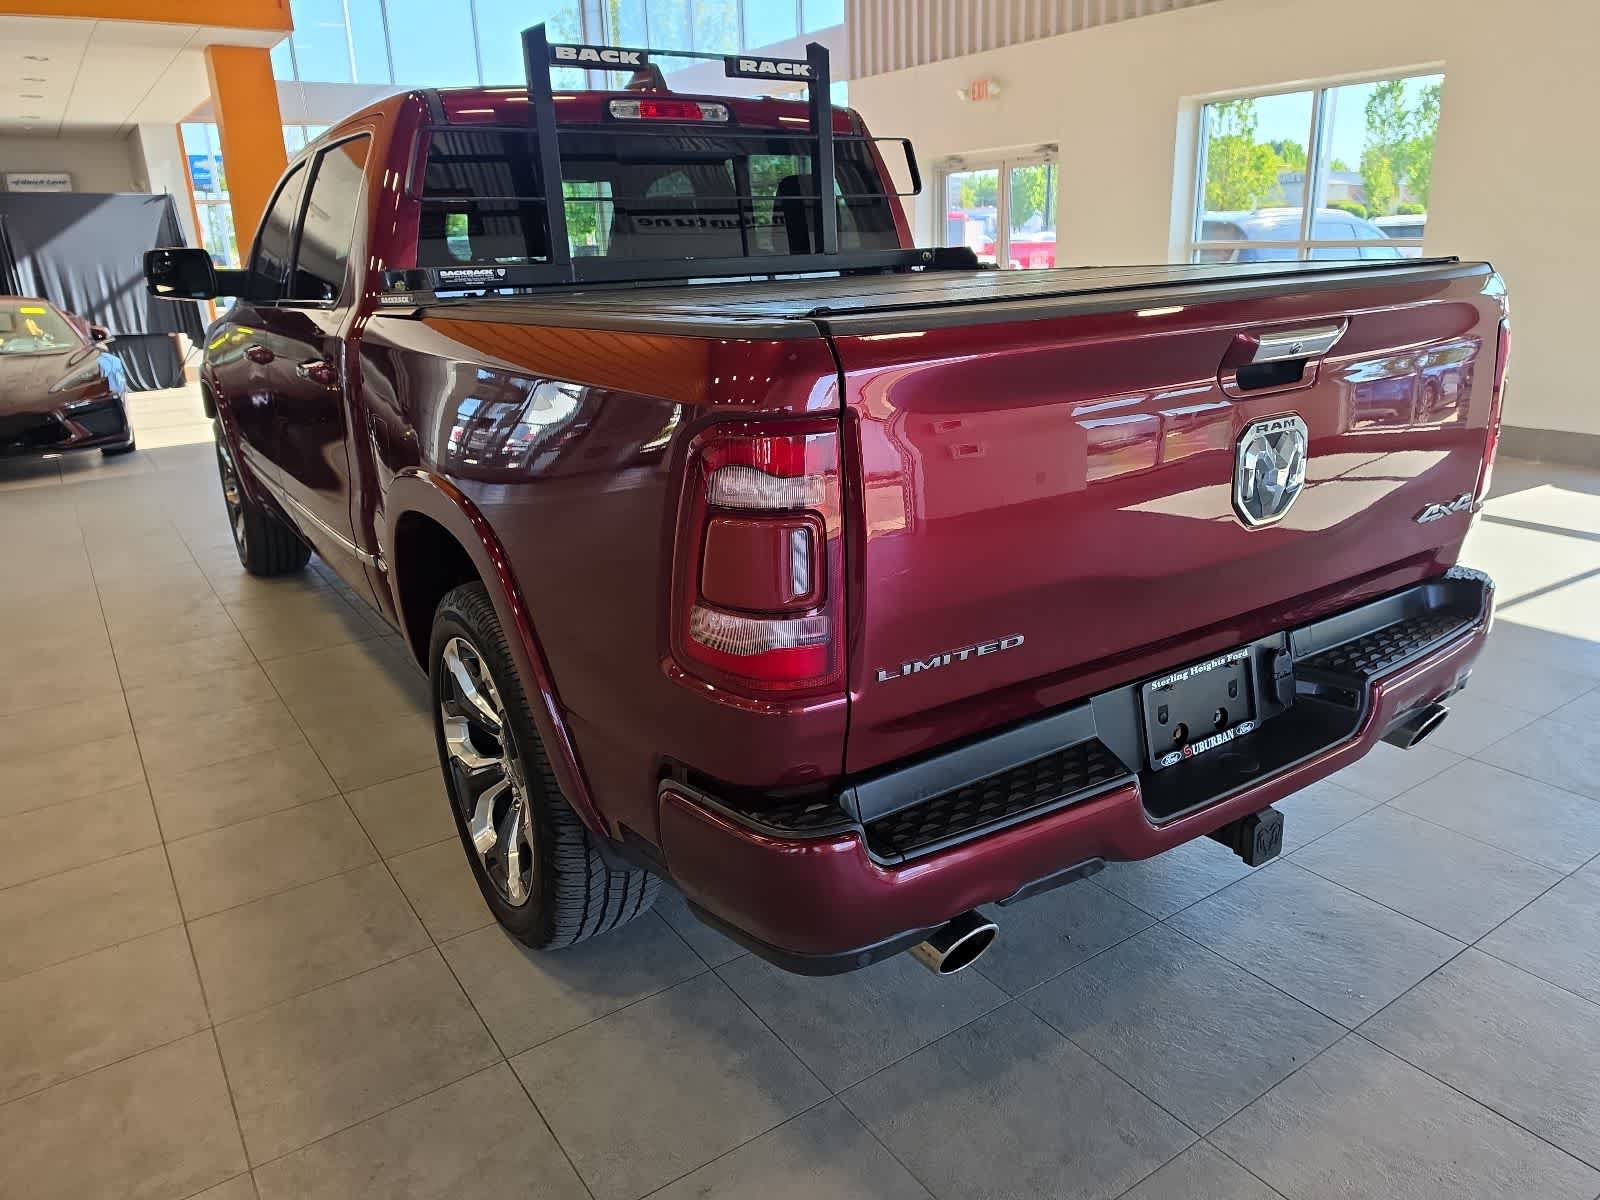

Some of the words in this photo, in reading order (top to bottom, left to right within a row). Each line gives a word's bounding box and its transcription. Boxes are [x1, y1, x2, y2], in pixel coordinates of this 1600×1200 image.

[555, 46, 641, 65] BACK
[739, 59, 810, 76] RACK
[439, 269, 494, 277] BACKRACK
[1255, 418, 1296, 434] RAM
[875, 633, 1025, 682] LIMITED
[1151, 670, 1189, 690] Sterling
[1190, 659, 1226, 676] Heights
[1227, 649, 1249, 663] Ford
[1183, 728, 1235, 758] SUBURBAN
